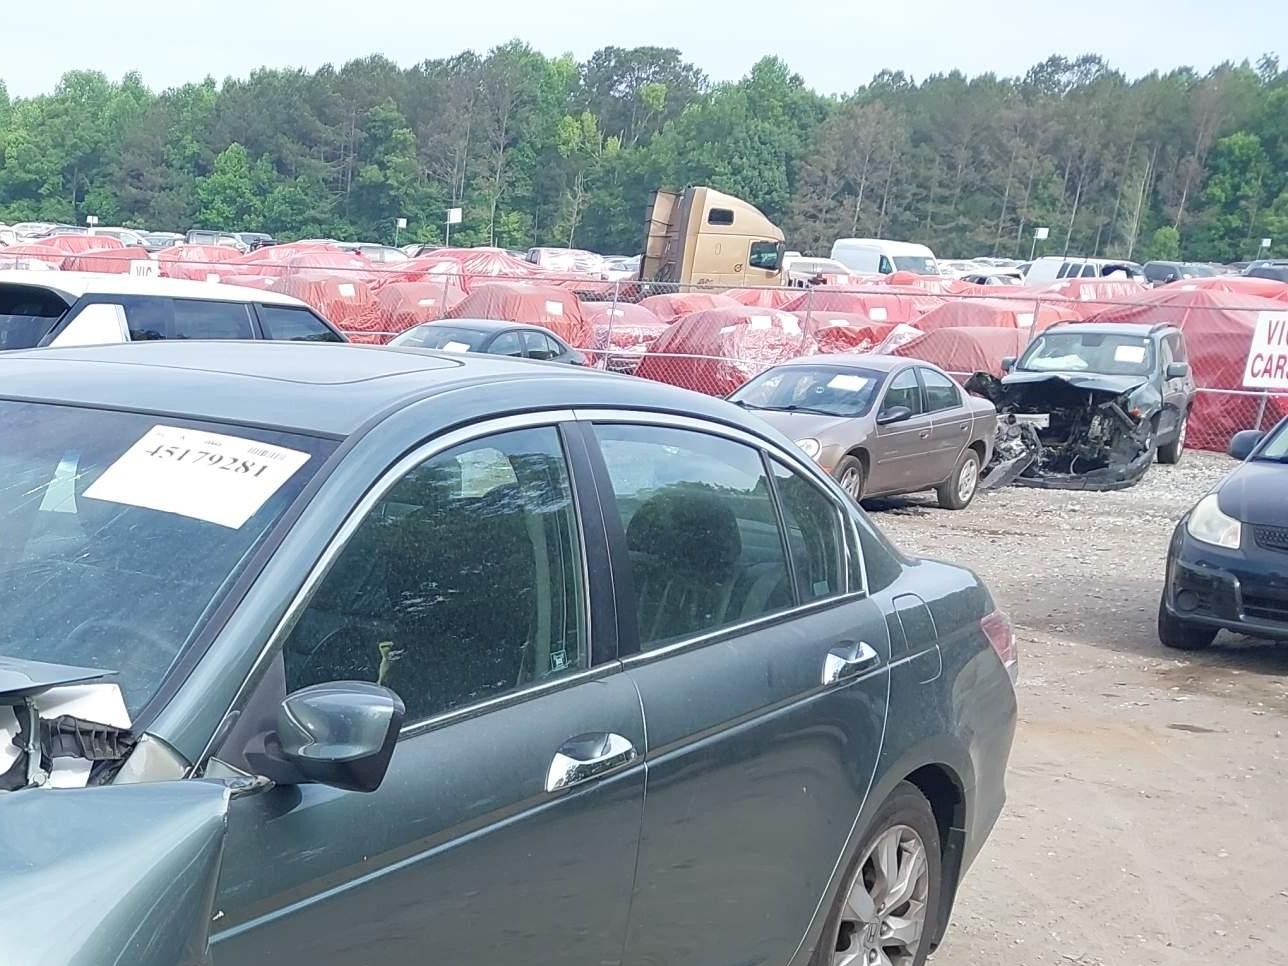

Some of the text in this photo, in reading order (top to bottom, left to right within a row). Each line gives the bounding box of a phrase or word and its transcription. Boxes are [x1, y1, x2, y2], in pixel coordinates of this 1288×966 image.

[1267, 320, 1288, 346] VI
[1251, 353, 1288, 379] CAR
[145, 444, 269, 477] 45179281
